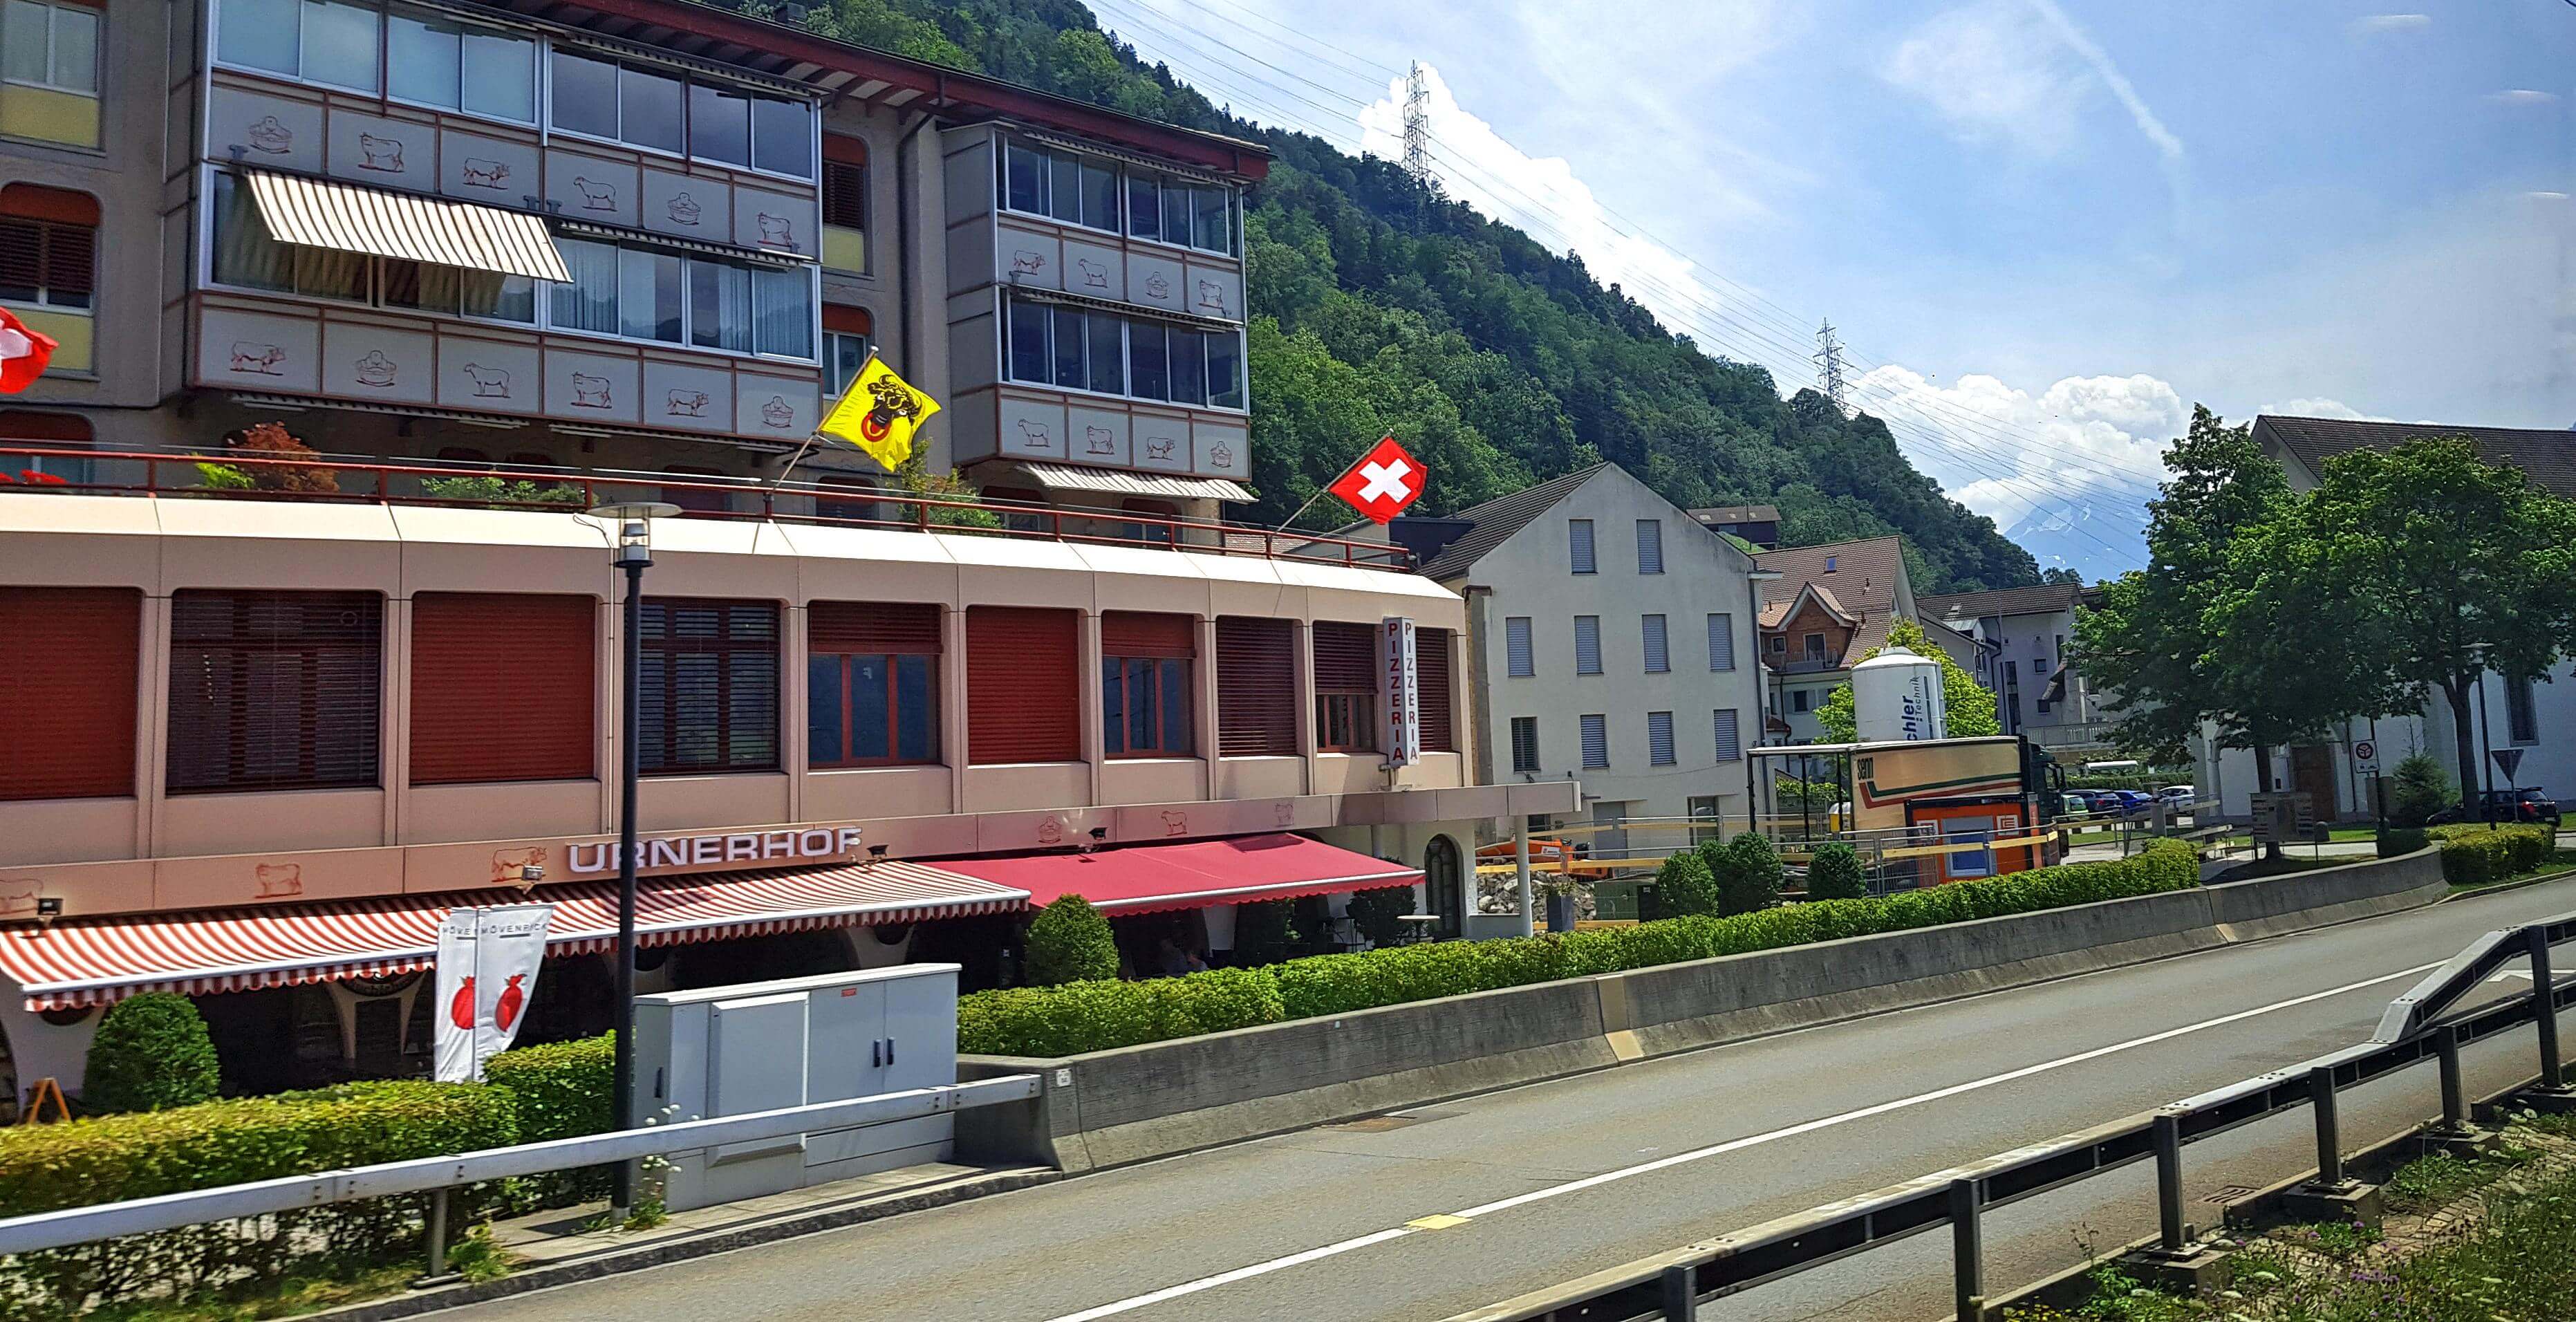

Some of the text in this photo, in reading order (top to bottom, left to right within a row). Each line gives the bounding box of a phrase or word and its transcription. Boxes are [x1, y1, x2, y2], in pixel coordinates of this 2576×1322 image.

[1388, 622, 1405, 761] PIZZERIA
[1405, 622, 1418, 760] PIZZERIA
[1910, 675, 1923, 716] Technik
[1901, 695, 1918, 741] chler
[568, 828, 863, 873] URNERHOF
